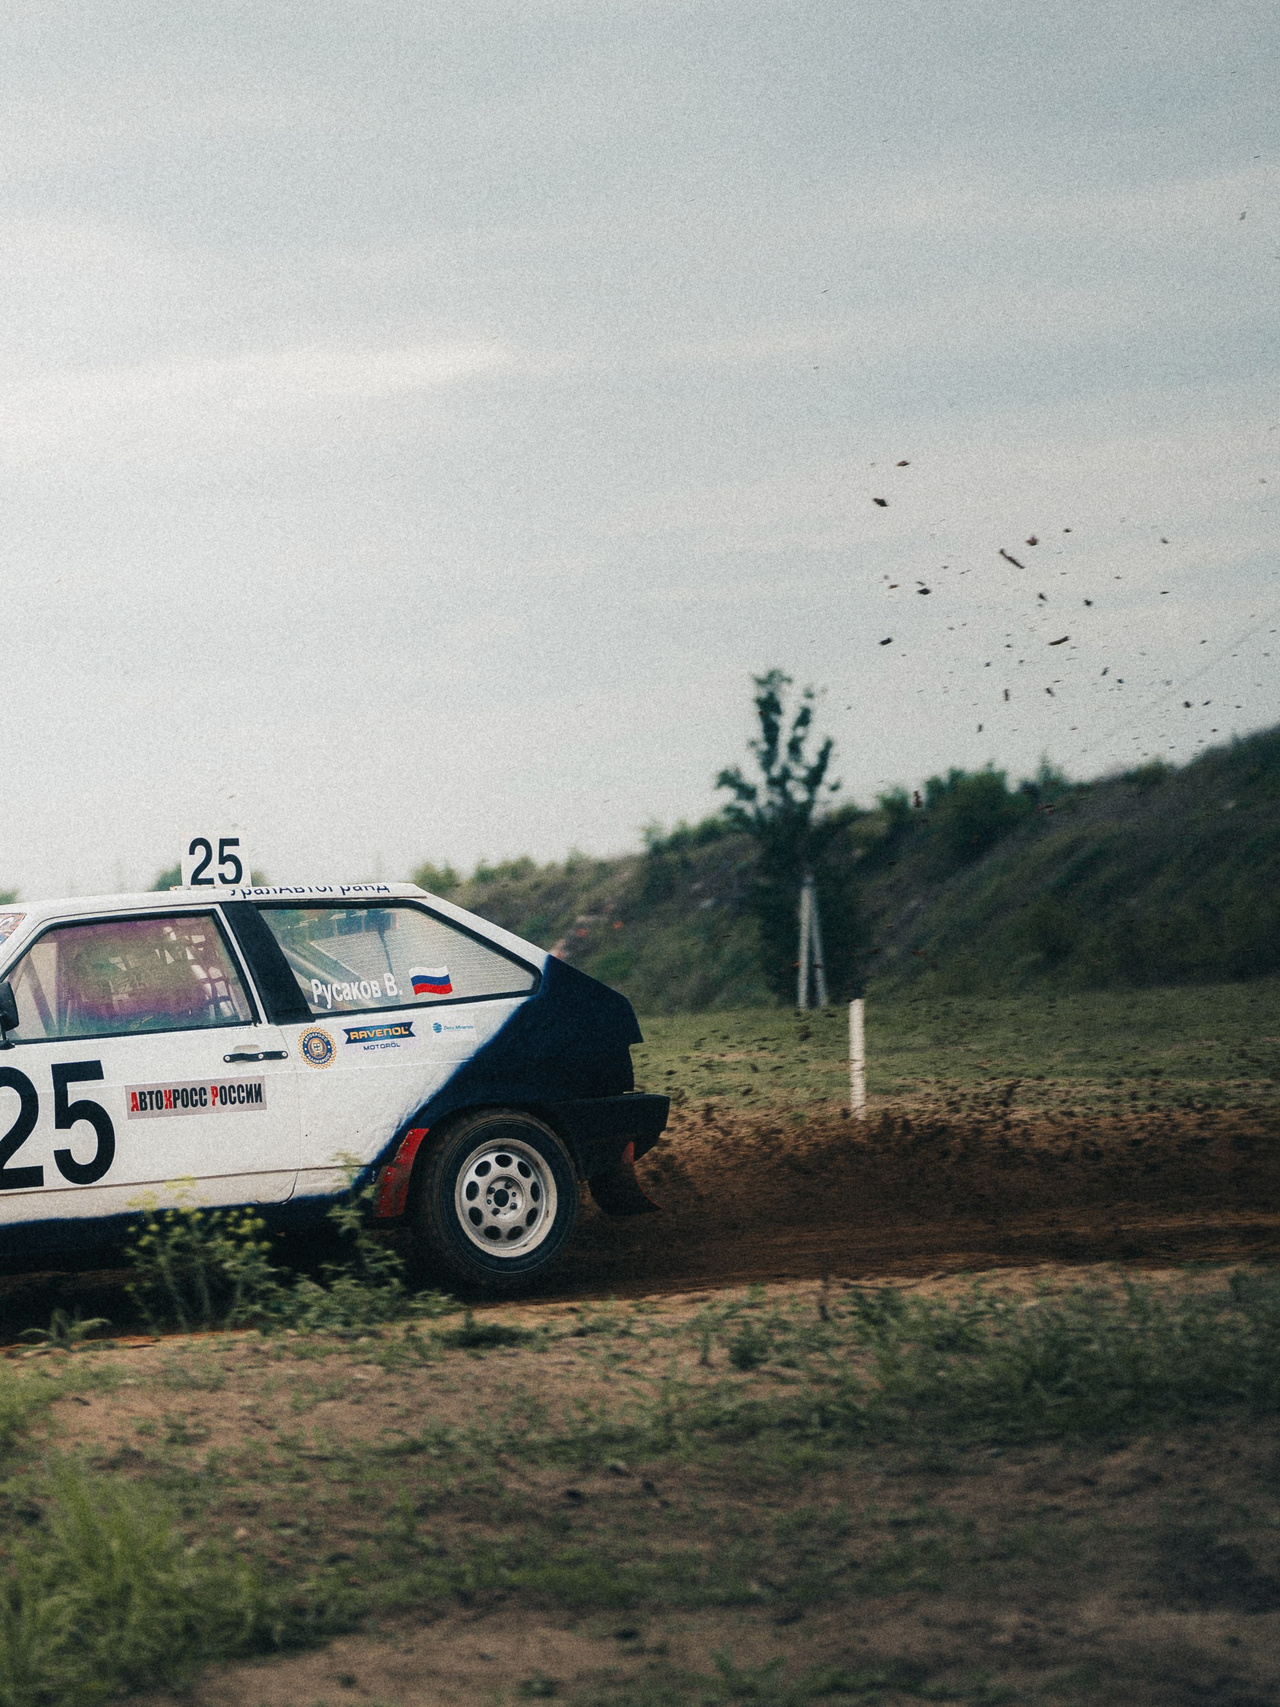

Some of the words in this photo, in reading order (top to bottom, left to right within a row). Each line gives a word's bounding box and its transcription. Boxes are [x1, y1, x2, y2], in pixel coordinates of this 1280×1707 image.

[188, 837, 243, 886] 25
[310, 978, 382, 1009] Русаков
[383, 972, 404, 997] В.
[349, 1026, 410, 1040] RAVENOL
[130, 1086, 208, 1112] АВТОКРОСС
[210, 1083, 263, 1107] РОССИИ
